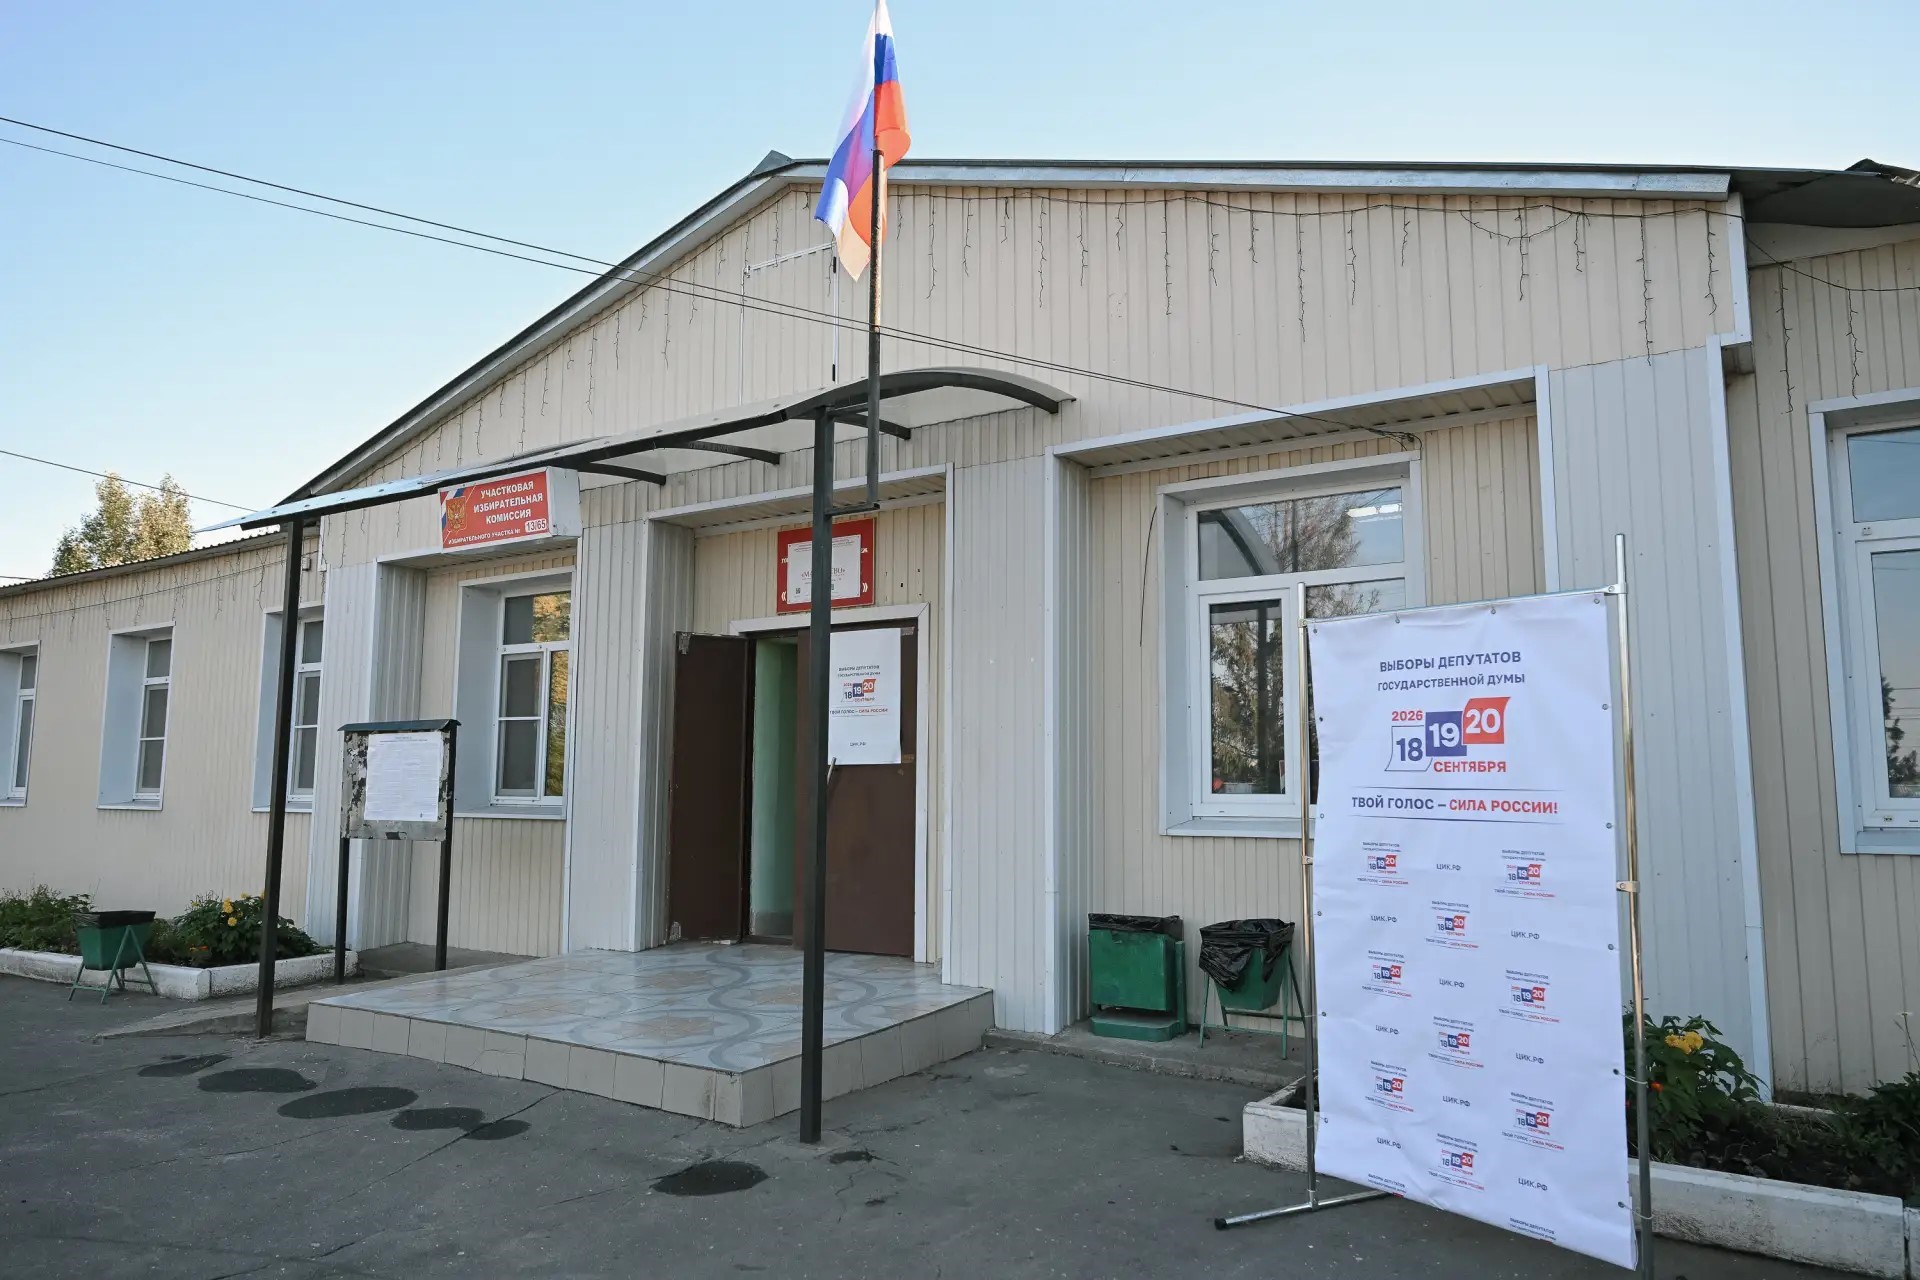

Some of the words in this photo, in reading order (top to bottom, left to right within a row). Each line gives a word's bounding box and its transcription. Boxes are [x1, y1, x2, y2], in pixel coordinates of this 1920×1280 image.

[480, 480, 533, 499] УЧАСТКОВАЯ
[473, 492, 543, 513] ИЗБИРАТЕЛЬНАЯ
[486, 509, 531, 524] КОМИССИЯ
[448, 532, 490, 544] ИЗБИРАТЕЛЬНОГО
[491, 529, 513, 538] УЧАСТКА
[526, 520, 546, 531] 13/65
[1380, 657, 1435, 672] ВЫБОРЫ
[1438, 651, 1521, 669] ДЕПУТАТОВ
[1377, 673, 1485, 691] ГОСУДАРСТВЕННОЙ
[1487, 673, 1526, 687] ДУМЫ
[1392, 710, 1423, 722] 2026
[1396, 738, 1423, 761] 18
[1428, 722, 1460, 748] 19
[1465, 708, 1501, 734] 20
[1433, 761, 1506, 773] СЕНТЯБРЯ
[1352, 795, 1384, 809] ТВОЙ
[1388, 798, 1434, 809] ГОЛОС
[1449, 799, 1486, 812] СИЛА
[1491, 801, 1558, 814] РОССИИ!
[1370, 914, 1397, 923] ЦИК.РФ
[1510, 929, 1540, 940] ЦИК.РФ
[1439, 979, 1465, 989] ЦИК.РФ
[1375, 1024, 1399, 1036] ЦИК.РФ
[1458, 1036, 1468, 1044] 20
[1515, 1052, 1544, 1065] ЦИК.РФ
[1442, 1094, 1471, 1108] ЦИК.РФ
[1517, 1118, 1525, 1126] 18
[1527, 1116, 1535, 1124] 19
[1537, 1115, 1547, 1123] 20
[1376, 1136, 1402, 1150] ЦИК.РФ
[1442, 1158, 1450, 1166] 18
[1452, 1156, 1460, 1164] 19
[1462, 1156, 1471, 1164] 20
[1518, 1177, 1548, 1192] ЦИК.РФ
